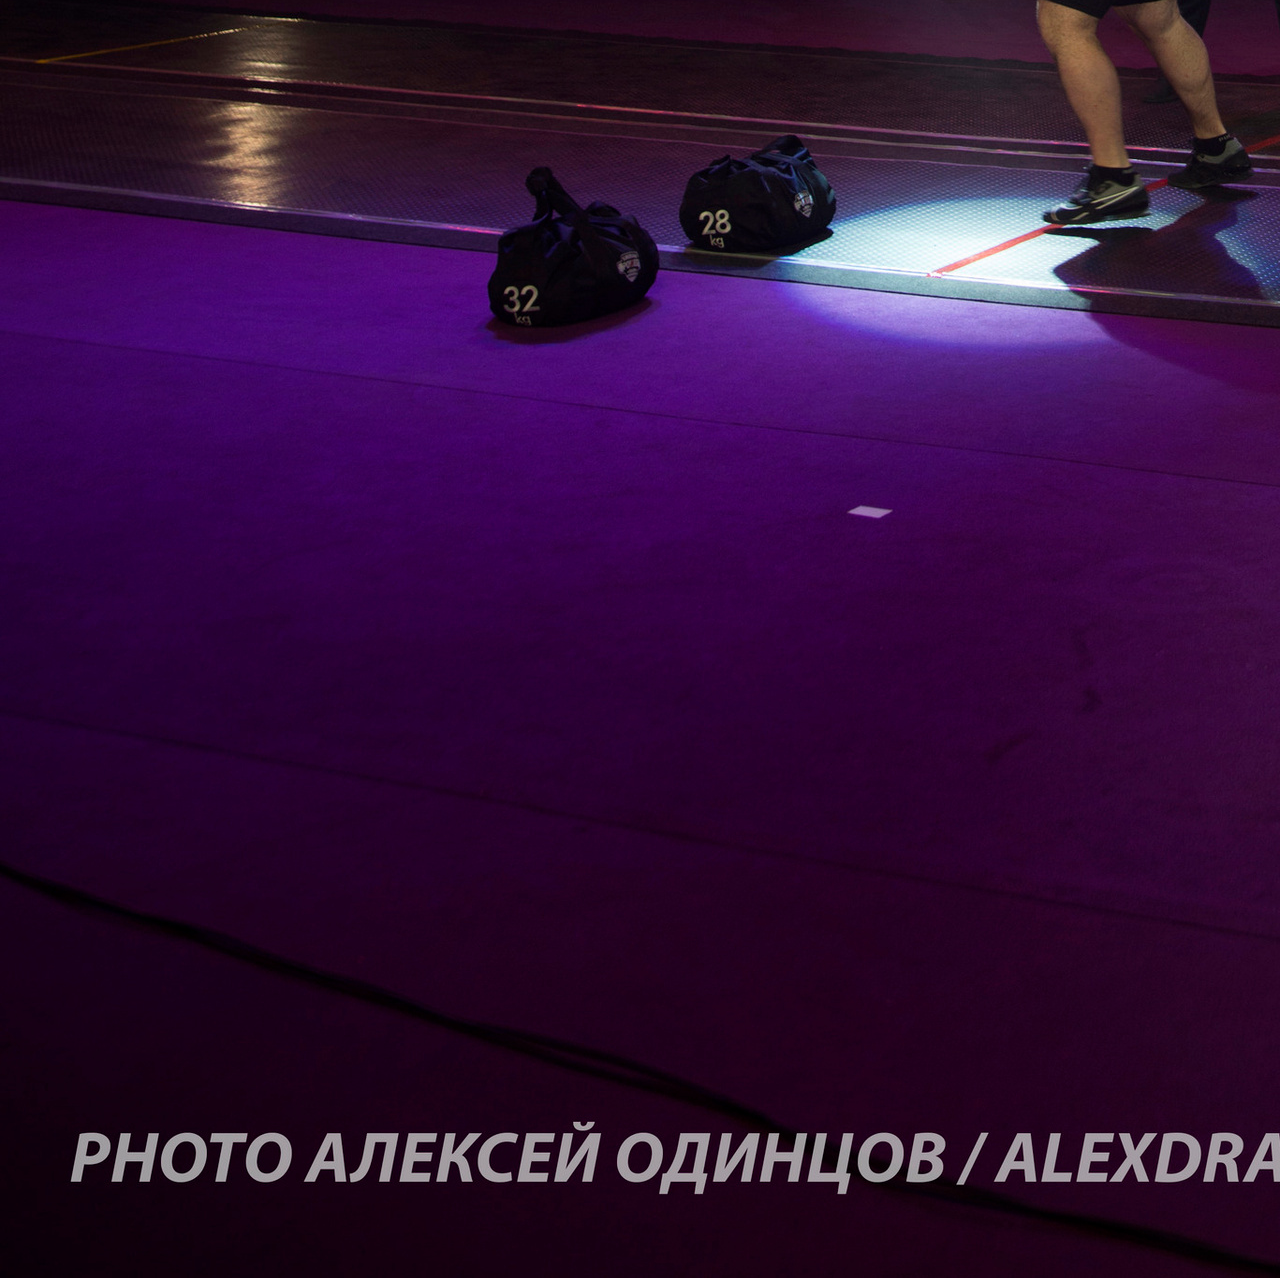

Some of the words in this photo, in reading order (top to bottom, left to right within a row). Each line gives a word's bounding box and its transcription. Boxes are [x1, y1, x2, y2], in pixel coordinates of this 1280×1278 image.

[698, 208, 732, 236] 28
[709, 234, 725, 249] kg
[503, 284, 541, 313] 32
[513, 312, 532, 327] kg
